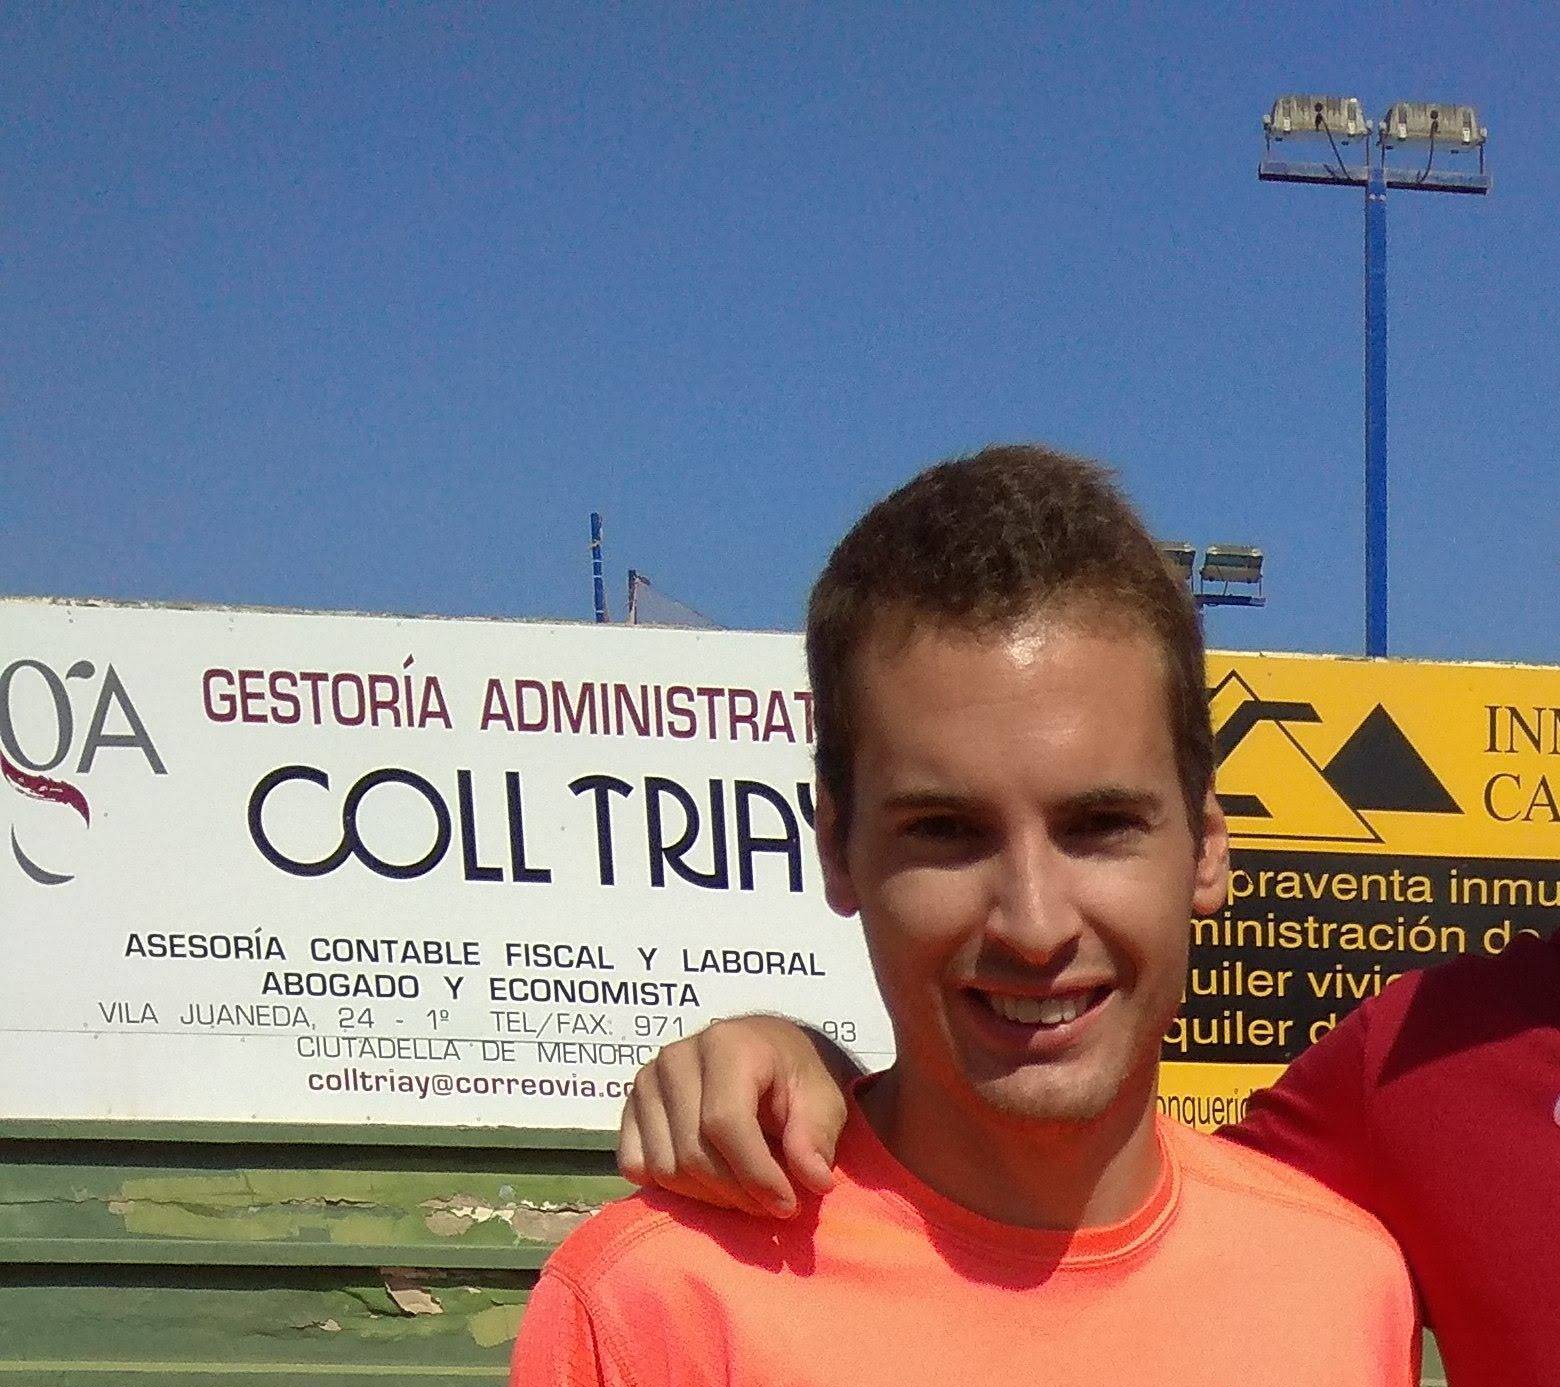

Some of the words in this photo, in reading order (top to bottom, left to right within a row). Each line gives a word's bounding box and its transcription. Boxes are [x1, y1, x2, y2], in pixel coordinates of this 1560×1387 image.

[202, 655, 452, 731] GESTORÍA
[247, 765, 552, 884] COLL
[1227, 867, 1433, 906] praventa
[125, 927, 286, 961] ASESORÍA
[310, 937, 481, 966] CONTABLE
[506, 943, 614, 970] FISCAL
[637, 948, 657, 971] Y
[683, 948, 826, 976] LABORAL
[1483, 920, 1539, 954] d
[261, 971, 420, 999] ABOGADO
[443, 976, 464, 1000] Y
[490, 977, 700, 1007] ECONOMISTA
[1181, 961, 1293, 1003] uiler
[1307, 964, 1402, 998] vivi
[98, 1002, 158, 1024] VILA
[180, 1003, 316, 1030] JUANEDA,
[338, 1008, 374, 1029] 24
[634, 1015, 684, 1038] 971
[822, 1021, 856, 1043] 93
[297, 1035, 461, 1061] CIUTADELLA
[482, 1040, 515, 1063] DE
[538, 1041, 653, 1066] MENORC
